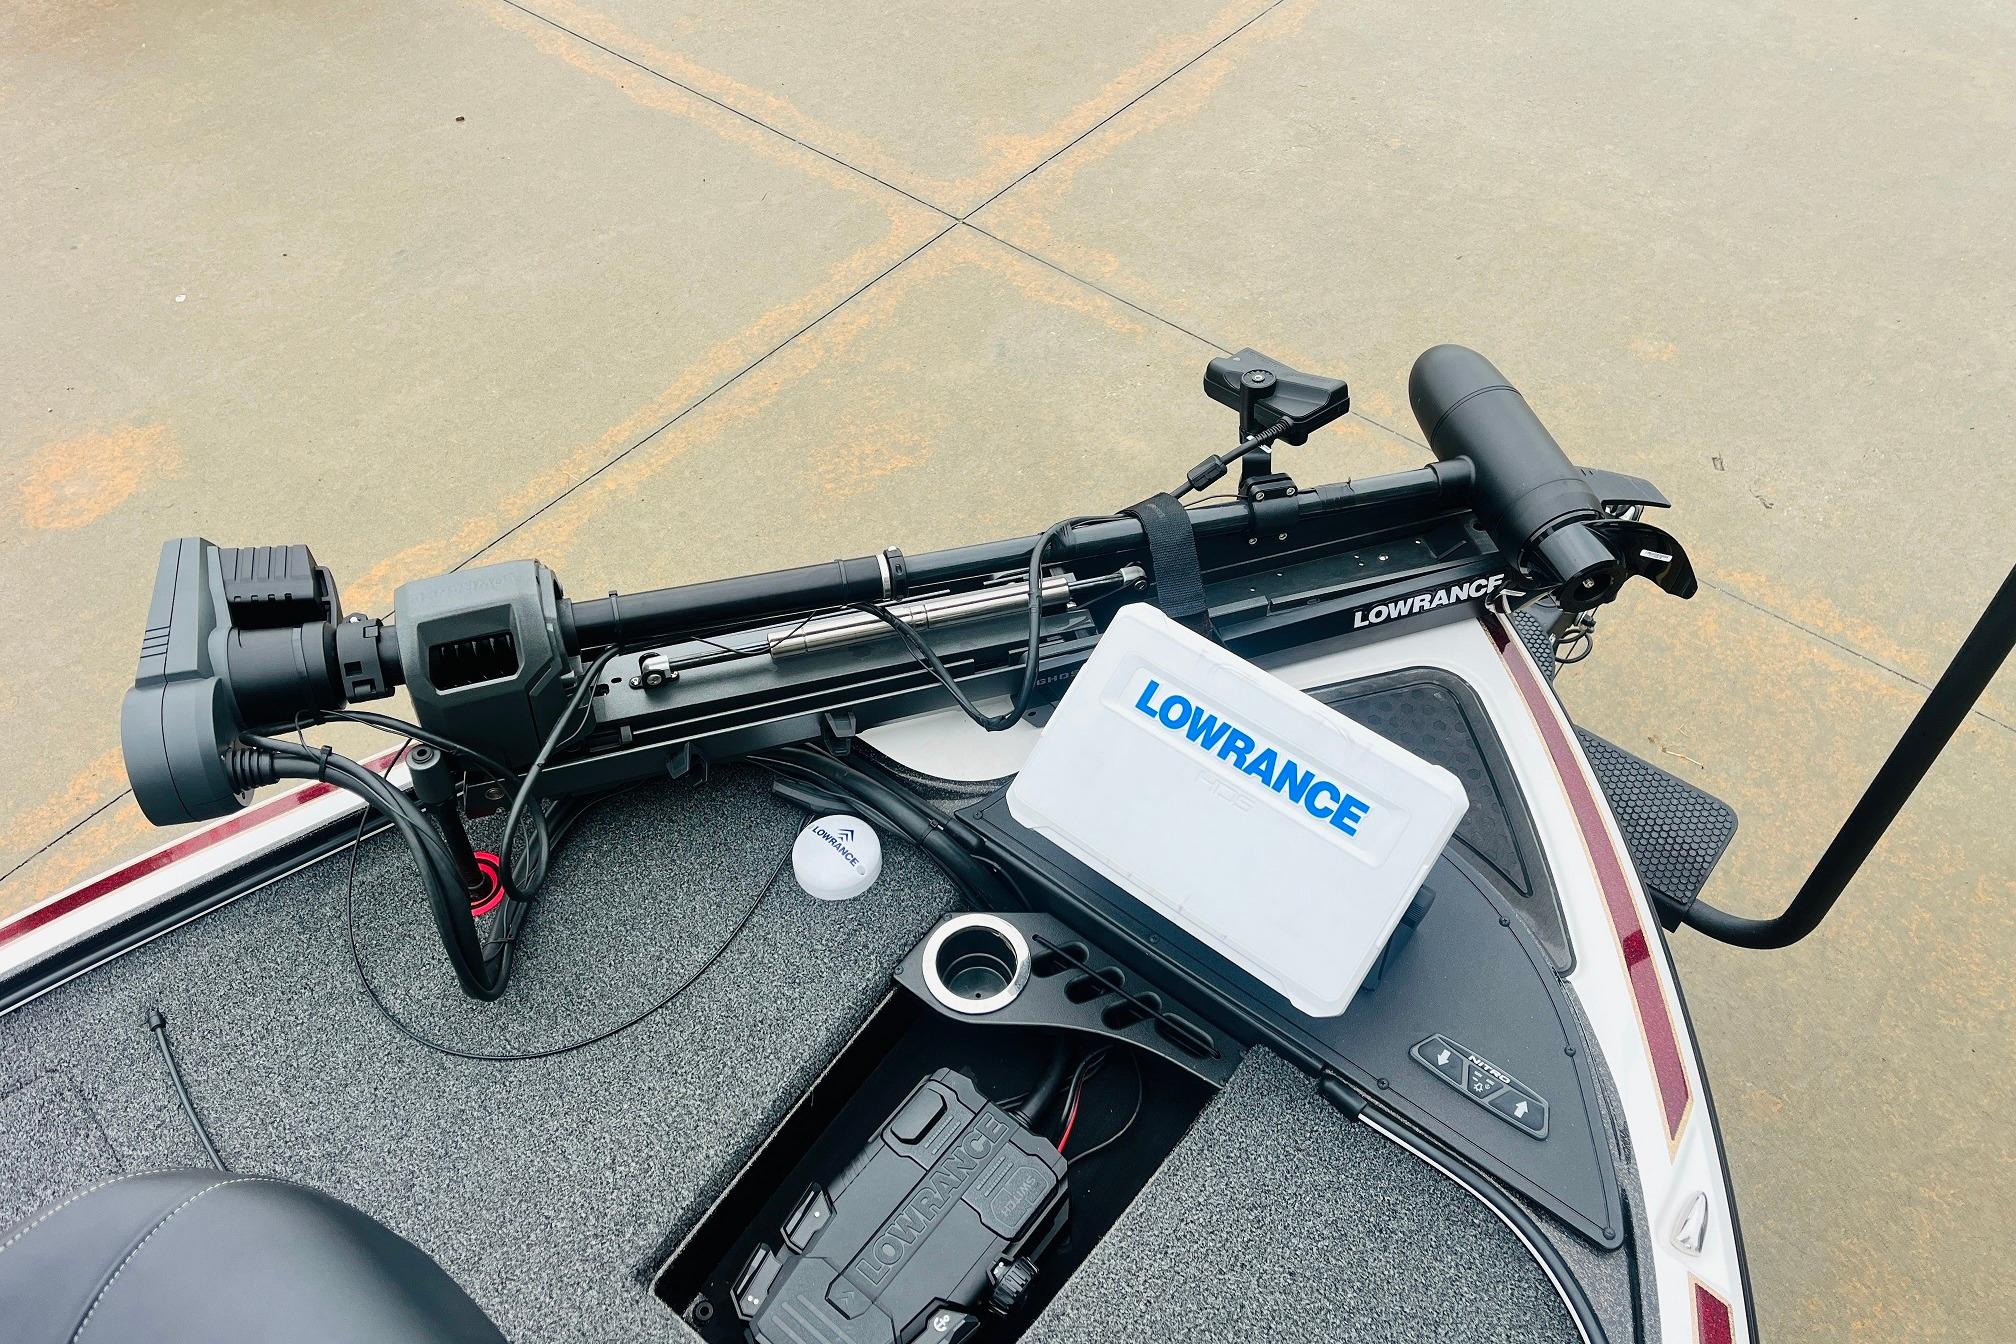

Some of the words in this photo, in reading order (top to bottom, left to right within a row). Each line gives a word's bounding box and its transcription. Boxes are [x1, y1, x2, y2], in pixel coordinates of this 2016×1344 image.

[1353, 573, 1504, 629] LOWRANCE
[1135, 680, 1370, 837] LOWRANCE
[812, 825, 860, 867] LOWRANCE
[1468, 1055, 1511, 1084] NITRO
[855, 1111, 1009, 1285] LOWRANCE
